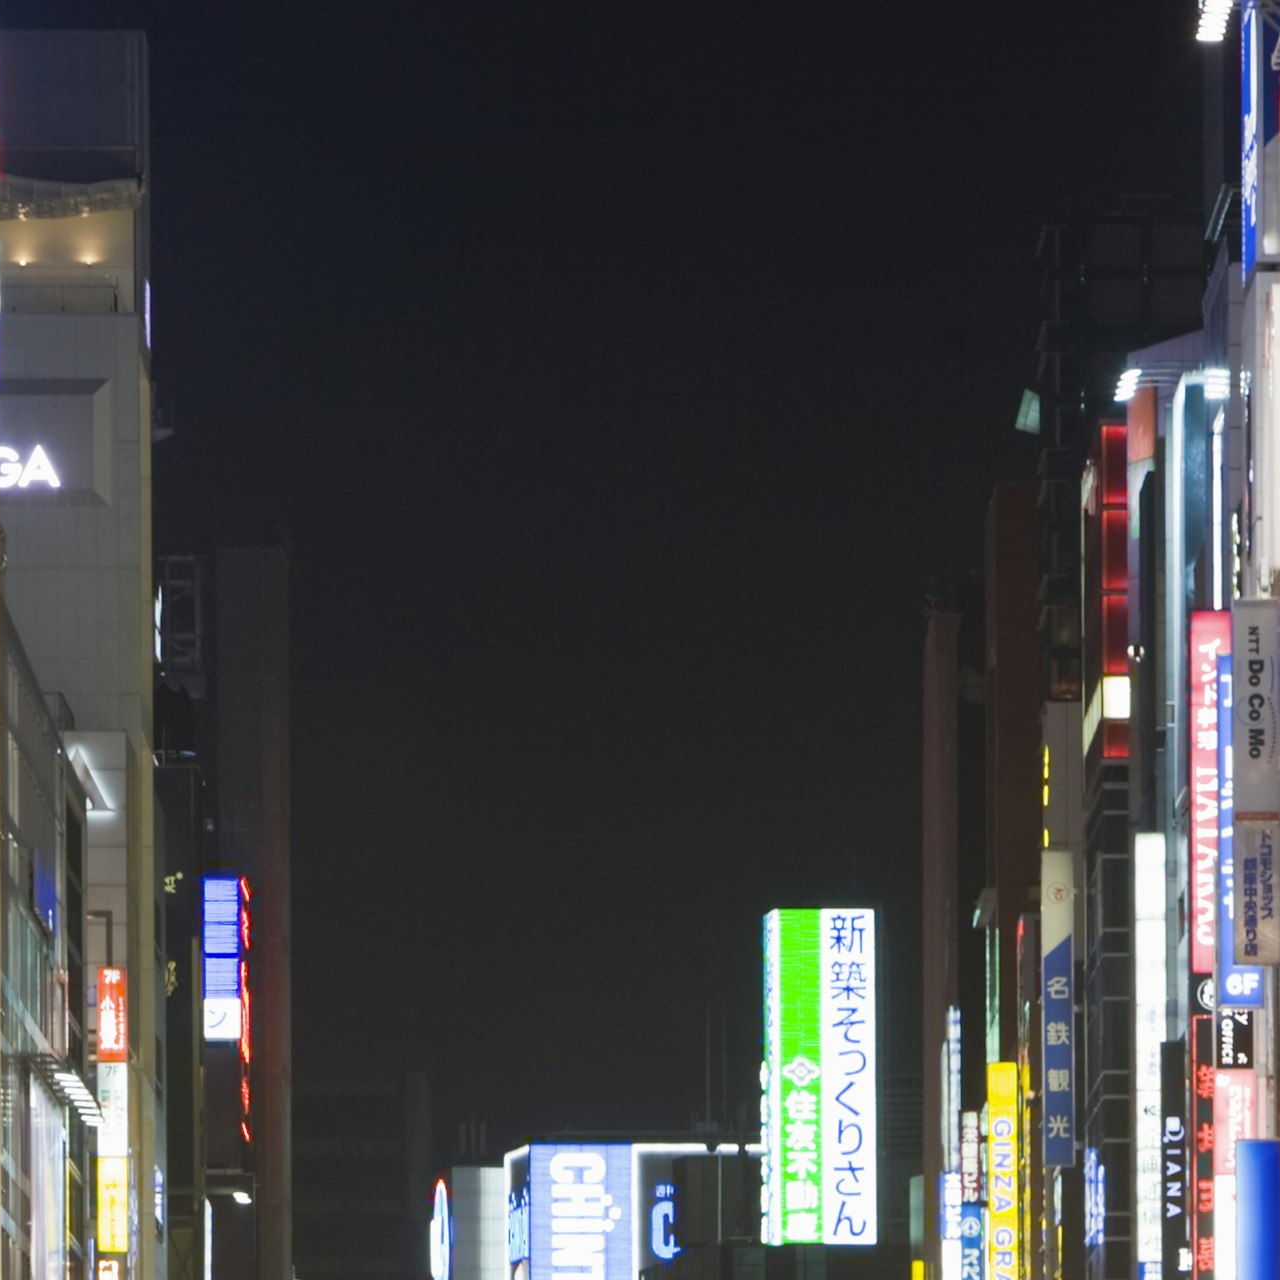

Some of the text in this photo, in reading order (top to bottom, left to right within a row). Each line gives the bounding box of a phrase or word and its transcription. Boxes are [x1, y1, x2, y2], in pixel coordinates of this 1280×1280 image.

[1247, 626, 1259, 654] NTT
[1226, 973, 1259, 995] 6F
[829, 914, 867, 1238] 新築そっくりさん
[1046, 976, 1071, 1138] 名鉄観光
[994, 1119, 1013, 1212] GINZA
[1163, 1116, 1185, 1218] DIANA
